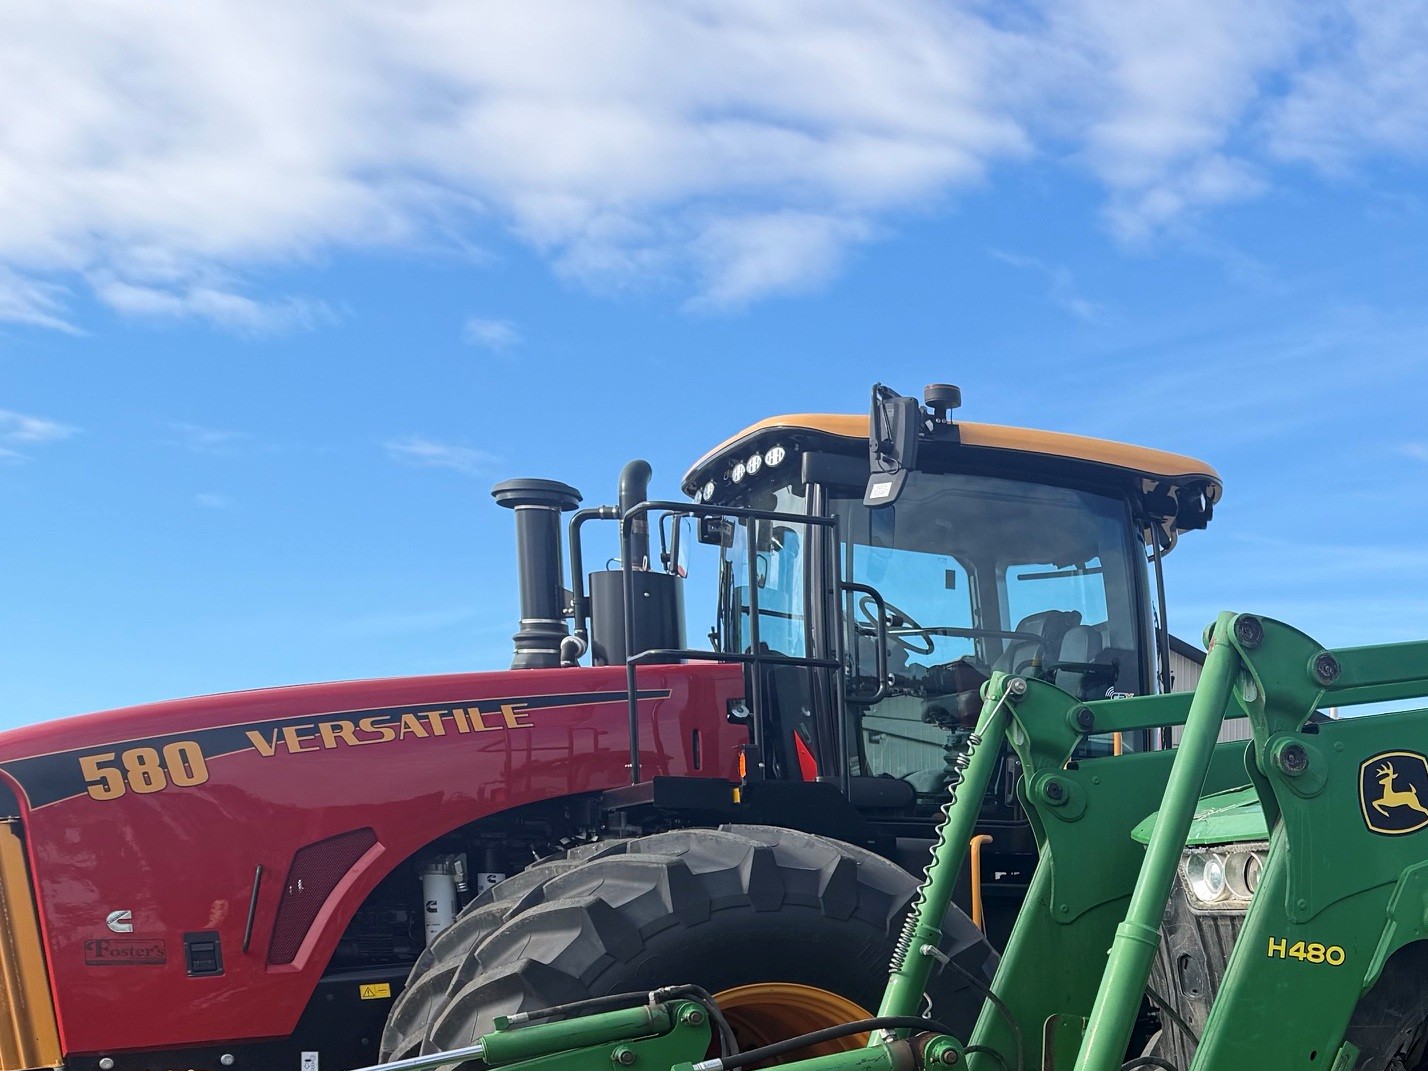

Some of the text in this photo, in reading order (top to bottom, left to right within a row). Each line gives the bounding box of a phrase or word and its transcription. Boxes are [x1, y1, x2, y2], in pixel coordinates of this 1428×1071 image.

[245, 702, 535, 757] VERSATILE
[78, 740, 210, 801] 580
[84, 938, 166, 958] Foster's
[1266, 935, 1347, 967] H480
